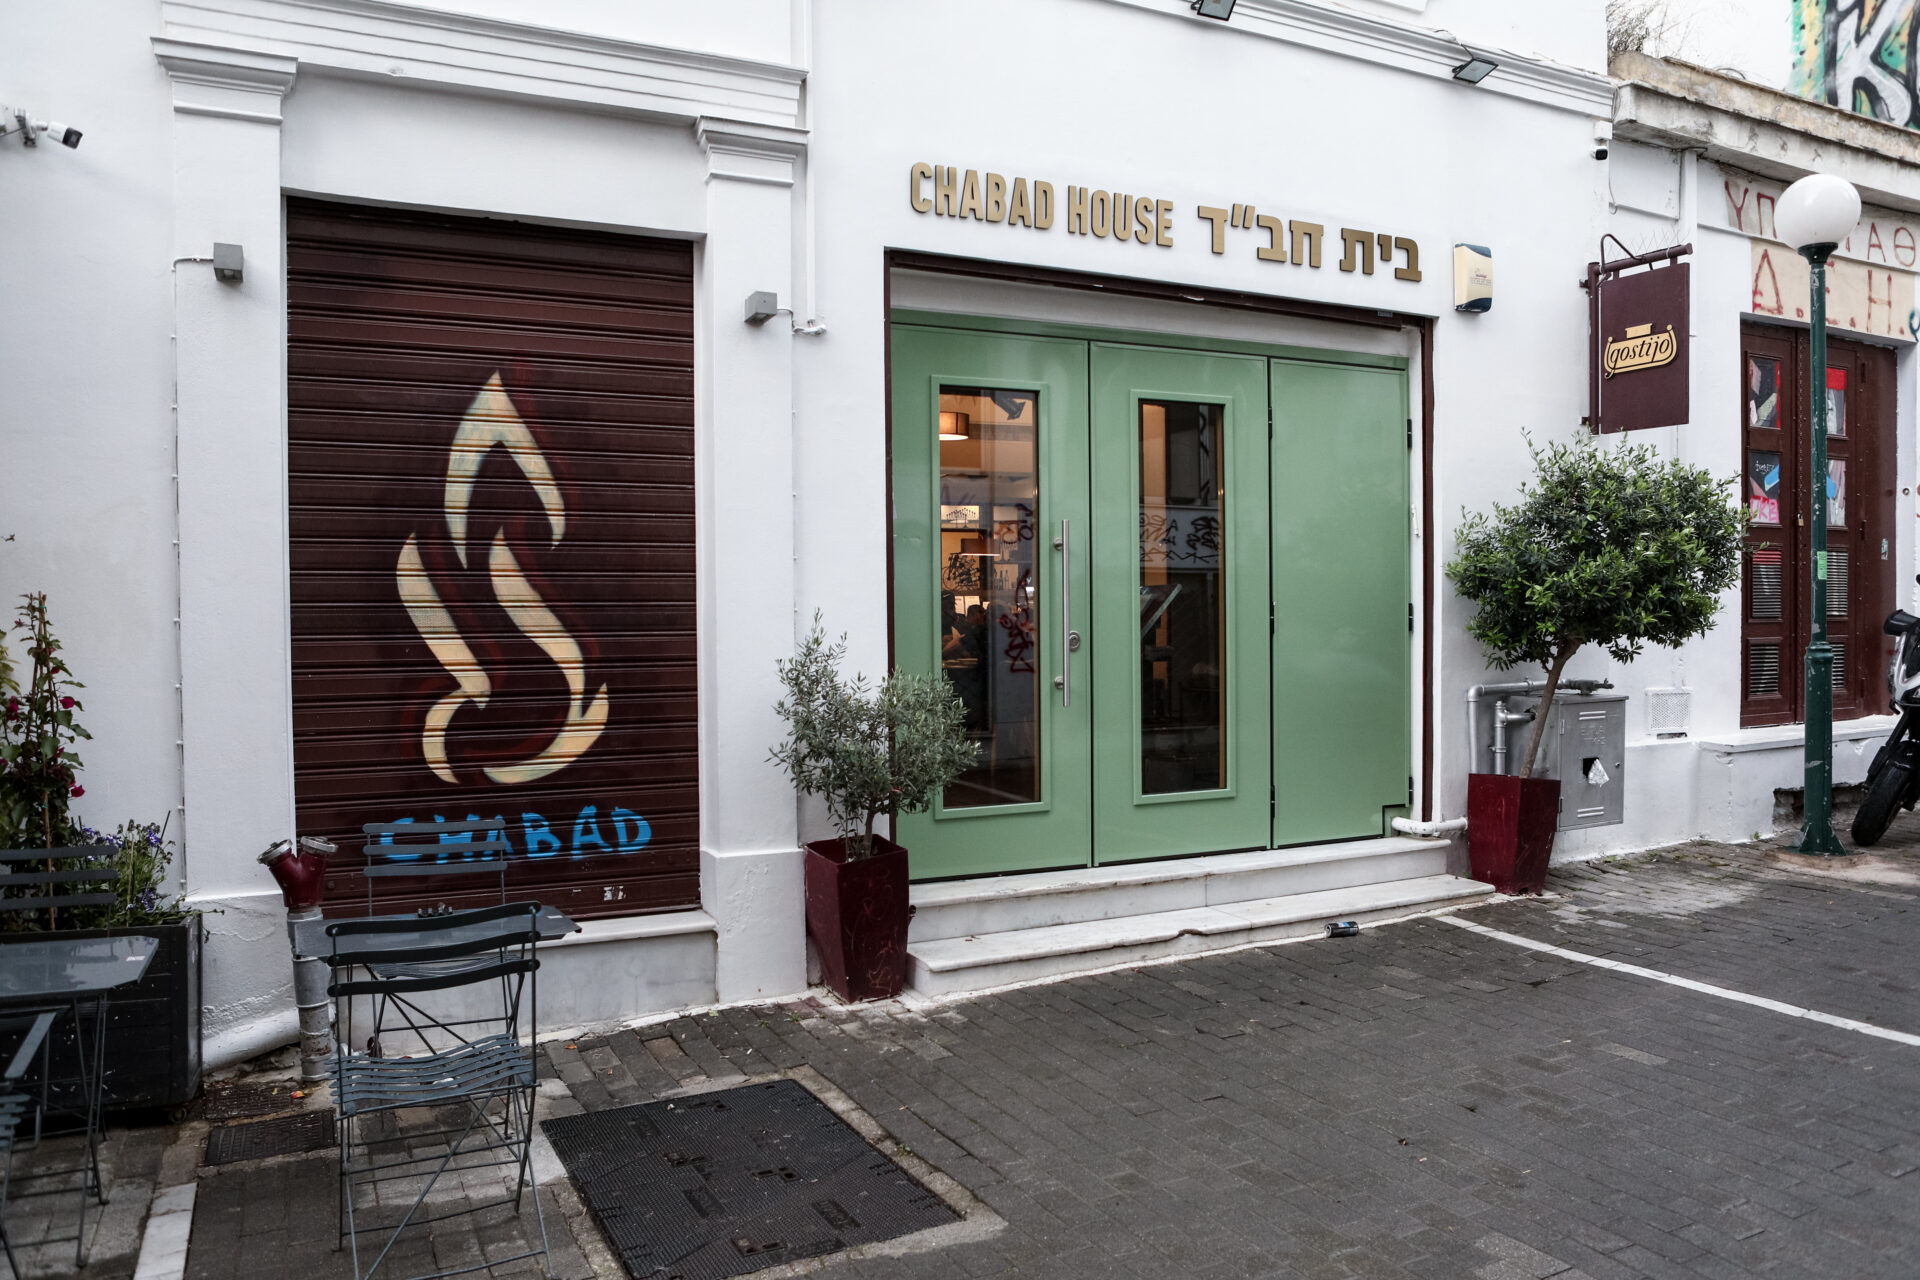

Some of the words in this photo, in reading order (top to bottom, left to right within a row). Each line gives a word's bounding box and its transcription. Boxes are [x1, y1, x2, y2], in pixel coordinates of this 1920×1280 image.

[910, 162, 1055, 232] CHABAD
[1067, 185, 1174, 249] HOUSE
[1339, 227, 1423, 284] בית
[1604, 336, 1671, 380] gostijo
